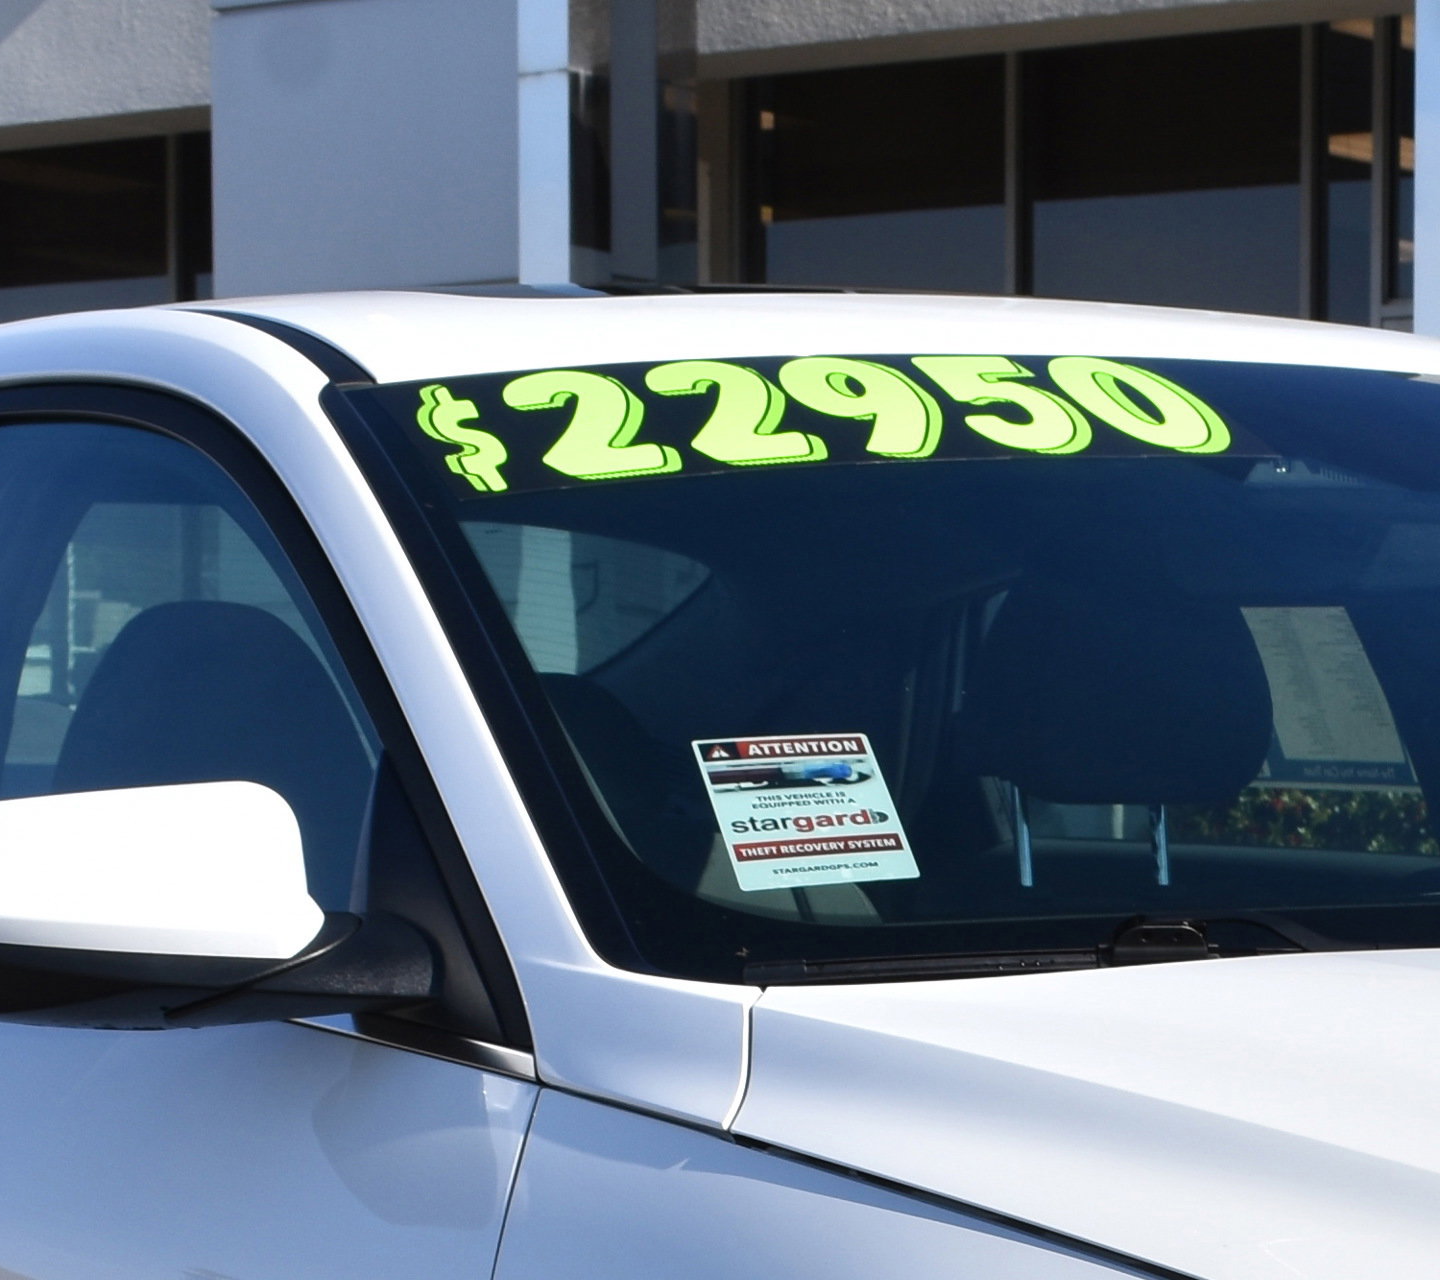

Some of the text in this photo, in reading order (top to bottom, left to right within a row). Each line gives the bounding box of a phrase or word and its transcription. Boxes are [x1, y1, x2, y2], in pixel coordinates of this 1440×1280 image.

[416, 355, 1231, 492] $22950
[748, 740, 859, 757] ATTENTION
[752, 797, 857, 810] EQUIPPED WITH A
[756, 791, 847, 802] THIS VEHICLE IS
[731, 809, 872, 832] stargard
[739, 837, 896, 858] THEFT RECOVERY SYSTEM
[772, 861, 879, 875] STARGARDGPS.COM
